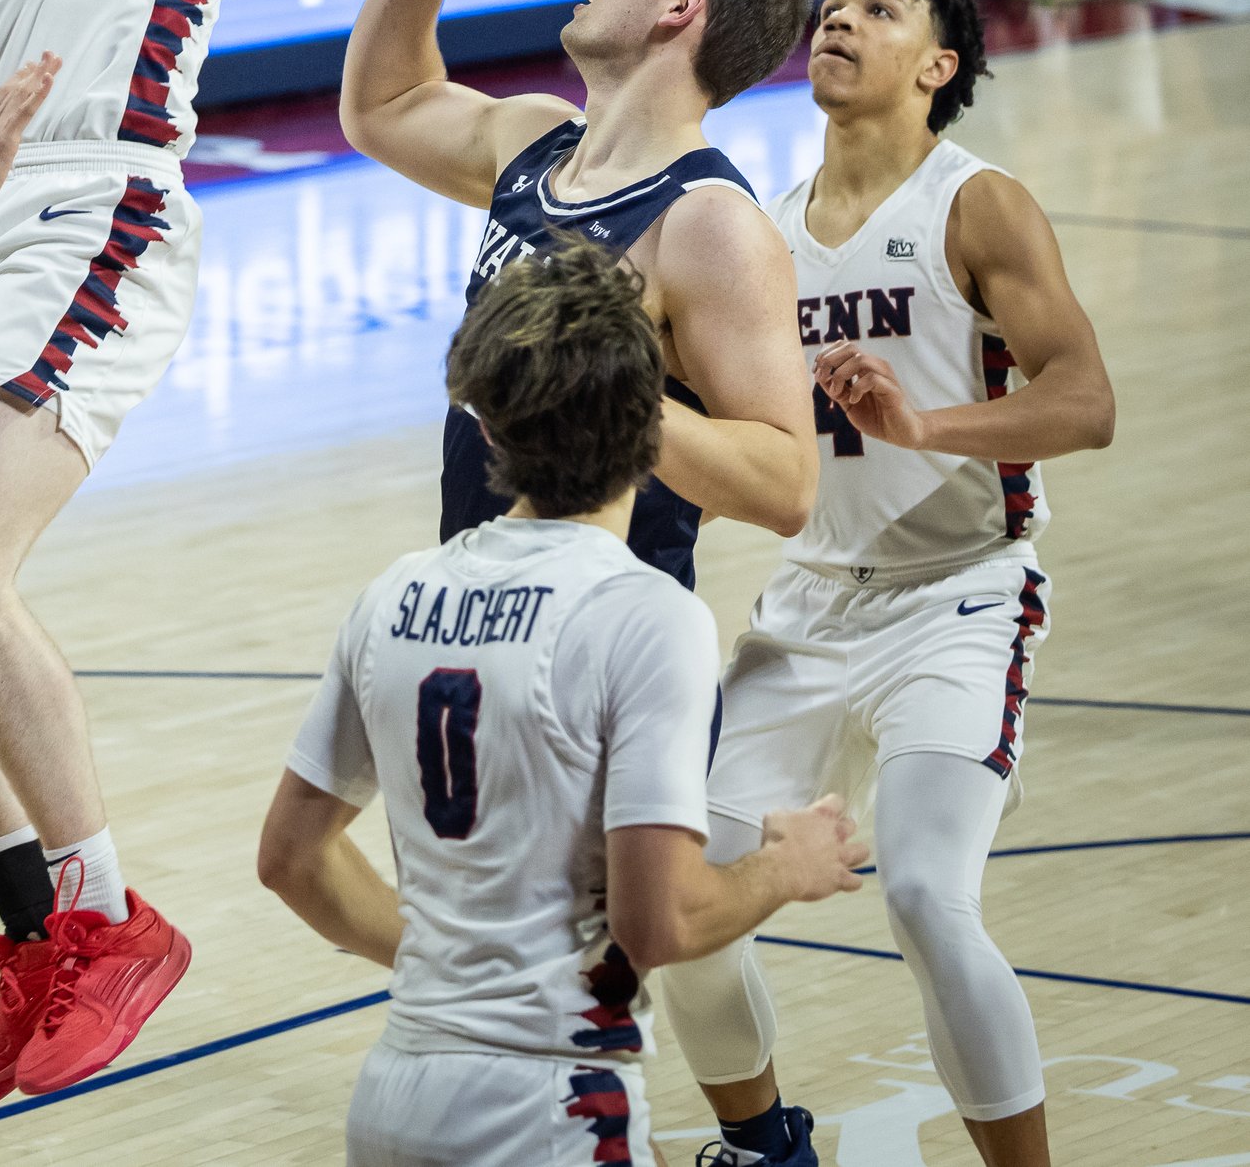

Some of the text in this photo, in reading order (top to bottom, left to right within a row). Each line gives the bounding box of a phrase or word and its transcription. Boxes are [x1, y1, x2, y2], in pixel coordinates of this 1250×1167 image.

[473, 219, 551, 286] YA
[798, 287, 915, 346] ENN
[391, 581, 554, 646] SLAJCHERT
[416, 667, 482, 840] 0
